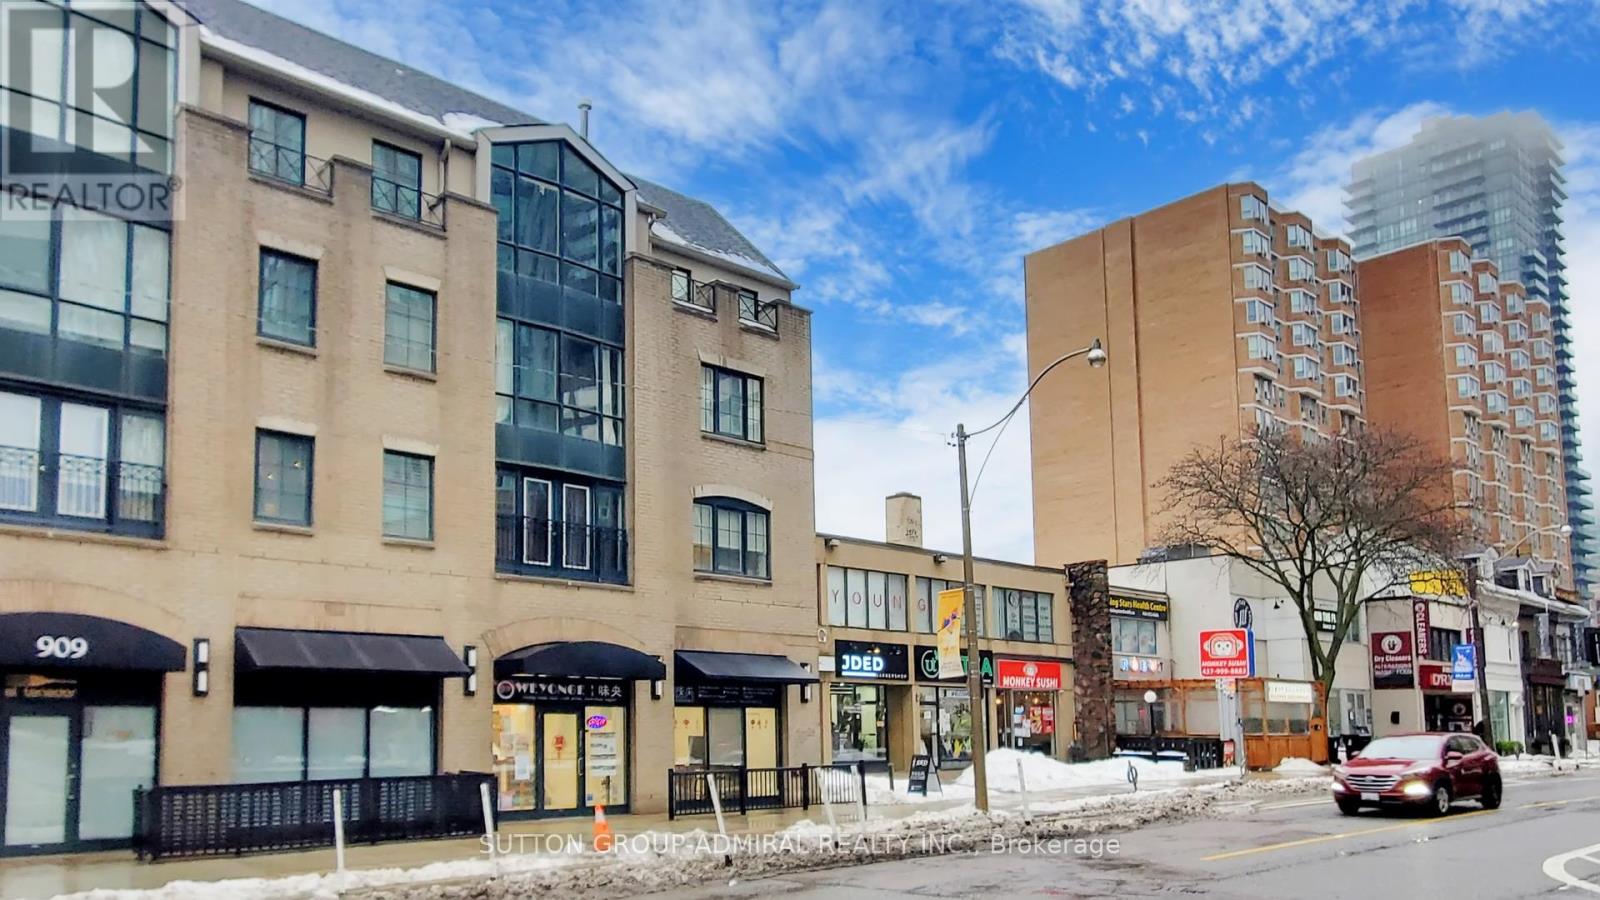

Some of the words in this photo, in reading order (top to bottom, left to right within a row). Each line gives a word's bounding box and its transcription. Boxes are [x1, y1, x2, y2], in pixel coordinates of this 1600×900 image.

[1119, 598, 1133, 609] Stars
[1133, 600, 1150, 610] Health
[1416, 612, 1428, 655] CLEANERS
[35, 635, 88, 658] 909
[841, 654, 883, 671] JDED
[1374, 655, 1385, 663] Dry
[1002, 676, 1035, 688] MONKEY
[1037, 677, 1058, 689] SUSHI
